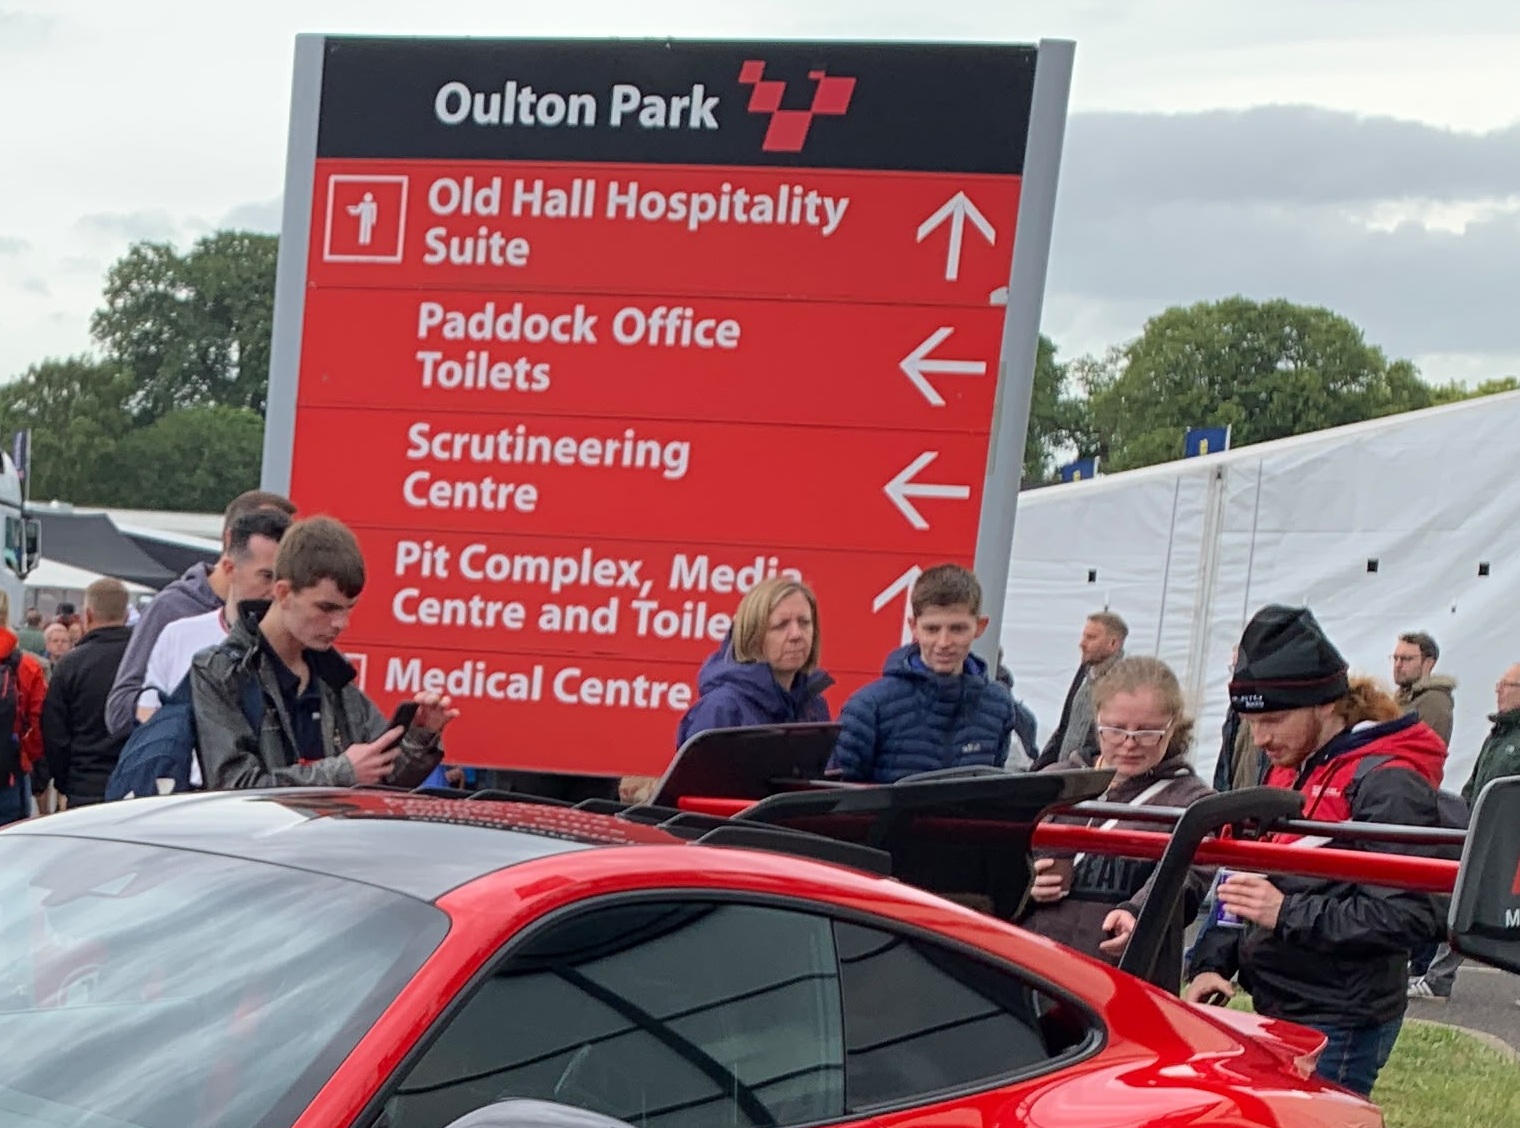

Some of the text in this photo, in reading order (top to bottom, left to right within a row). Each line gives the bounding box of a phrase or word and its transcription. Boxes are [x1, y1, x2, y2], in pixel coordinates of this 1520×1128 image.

[435, 81, 720, 129] Oulton Park
[428, 176, 849, 236] Old Hall Hospitality
[423, 225, 530, 266] Suite
[418, 302, 741, 348] Paddock Office
[416, 350, 550, 391] Toilets
[406, 422, 690, 479] Scrutineering
[403, 470, 538, 511] Centre
[395, 540, 450, 578] Pit
[459, 543, 653, 598] Complex,
[392, 587, 742, 641] Centre and Toile
[385, 657, 693, 710] Medical Centre
